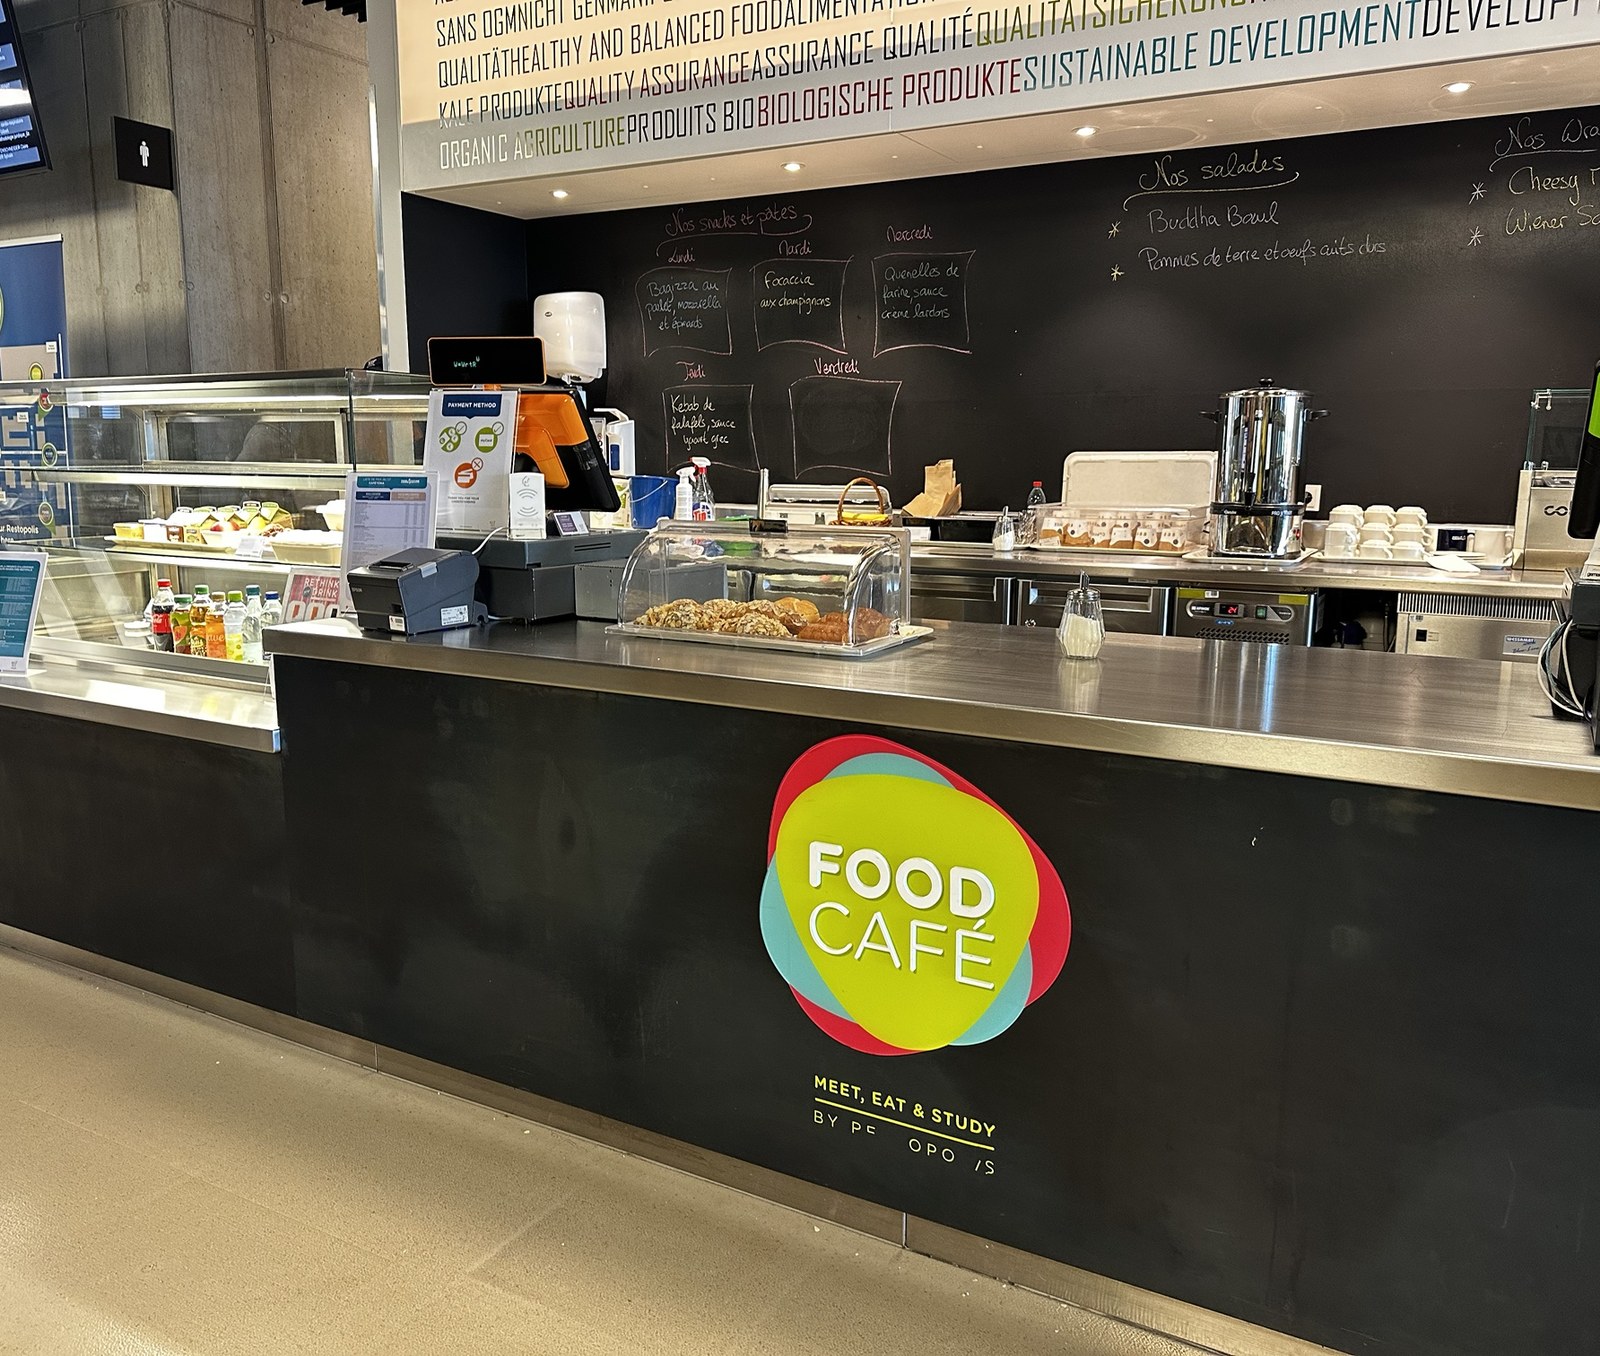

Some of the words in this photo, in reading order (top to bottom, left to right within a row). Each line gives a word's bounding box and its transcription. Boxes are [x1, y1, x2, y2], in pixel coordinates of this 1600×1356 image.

[437, 13, 477, 47] SANS
[589, 28, 623, 62] AND
[631, 9, 724, 55] BALANCED
[1494, 116, 1546, 157] Nos
[440, 133, 509, 170] ORGANIC
[1139, 154, 1190, 191] Nos
[1200, 149, 1287, 181] salades
[1508, 166, 1580, 206] Cheesy
[665, 207, 696, 237] Nos
[700, 209, 738, 232] snacks
[740, 206, 755, 225] et
[756, 202, 798, 235] pâtes
[1147, 204, 1221, 233] Buddha
[1226, 200, 1280, 227] Bowl
[1505, 207, 1568, 236] Wiener
[886, 224, 933, 243] Mercredi
[667, 247, 695, 264] Lundi
[1138, 247, 1200, 271] Pommes
[1203, 246, 1223, 267] de
[1225, 245, 1260, 264] terre
[1319, 235, 1355, 256] cuits
[1358, 233, 1387, 255] durs
[764, 270, 815, 290] Focaccia
[884, 261, 941, 281] Quenelles
[945, 261, 960, 278] de
[702, 281, 719, 292] au
[913, 286, 949, 299] sauce
[760, 297, 777, 309] aux
[778, 290, 832, 316] champignons
[658, 315, 670, 331] et
[813, 357, 860, 375] Vendredi
[670, 393, 700, 413] Kebab
[703, 395, 716, 411] de
[710, 418, 737, 430] sauce
[710, 432, 729, 450] grec
[6, 524, 39, 535] Restopolis
[304, 577, 340, 589] RETHINK
[311, 587, 338, 599] DRINK
[808, 840, 996, 919] FOOD
[808, 901, 997, 991] CAFÉ
[814, 1074, 865, 1104] MEET,
[872, 1091, 907, 1113] EAT
[913, 1103, 925, 1119] &
[931, 1108, 997, 1138] STUDY
[813, 1109, 839, 1128] BY
